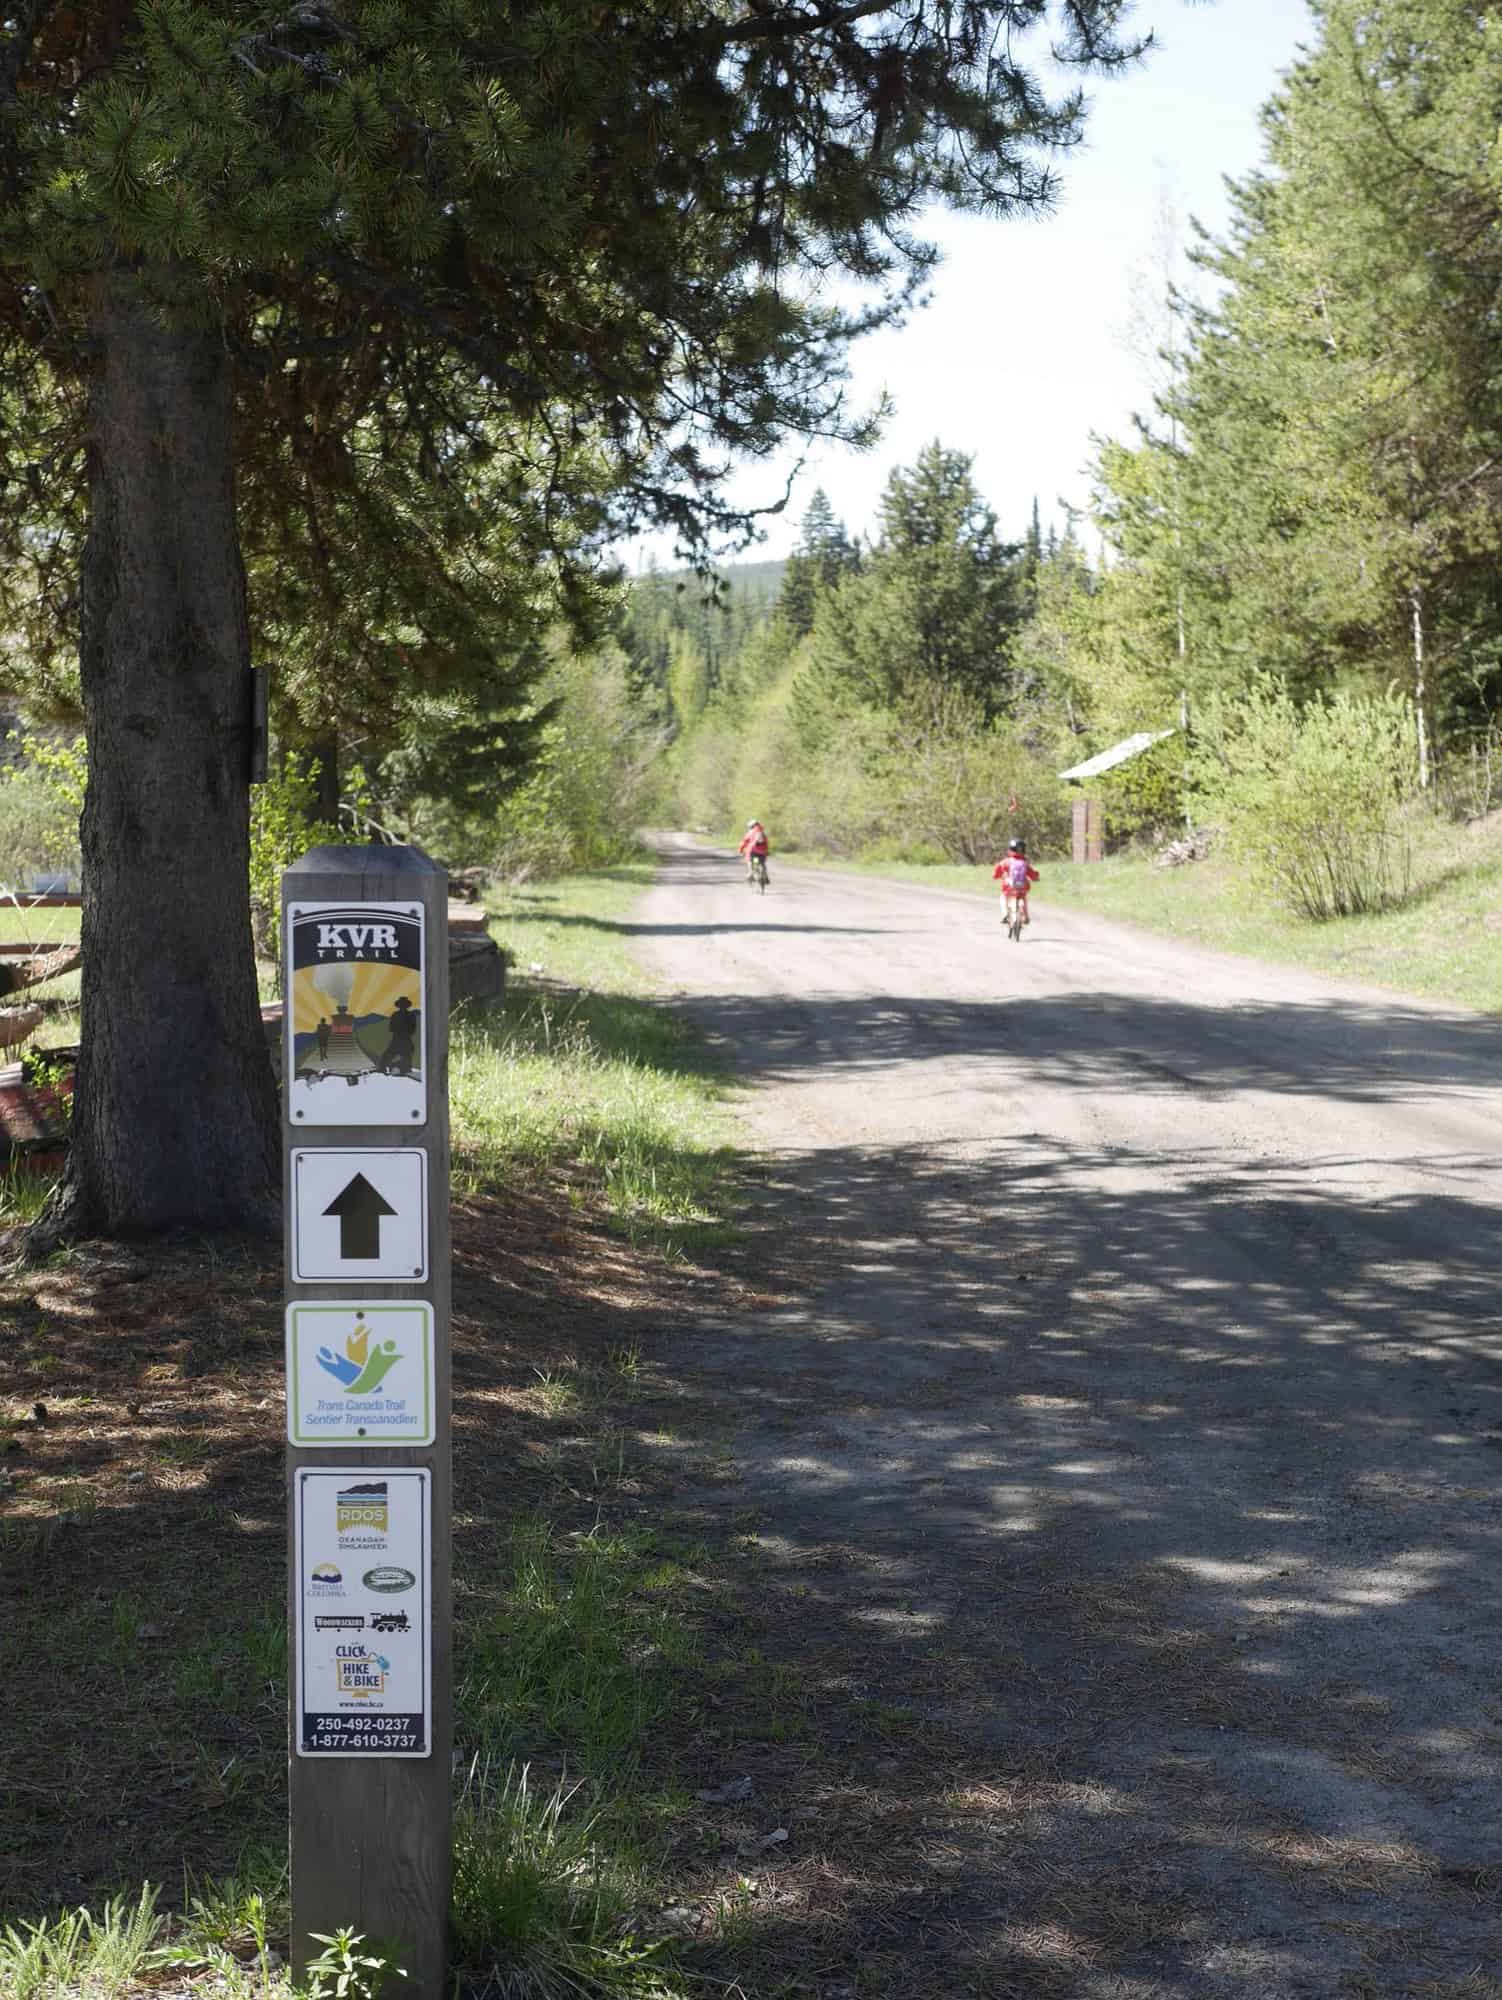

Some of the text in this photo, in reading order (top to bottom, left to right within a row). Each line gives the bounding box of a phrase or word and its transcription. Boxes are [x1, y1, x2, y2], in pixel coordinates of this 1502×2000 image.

[317, 924, 399, 948] KVR
[317, 950, 398, 958] TRAIL
[346, 1399, 383, 1409] Canada
[385, 1399, 406, 1409] Trail
[304, 1415, 342, 1425] Sentier
[340, 1510, 384, 1520] RDOS
[336, 1646, 367, 1657] CLICK
[343, 1663, 369, 1674] HIKE
[343, 1675, 380, 1686] & BIKE
[317, 1718, 410, 1730] 250-492-0237
[311, 1734, 416, 1746] 1-877-610-3737
